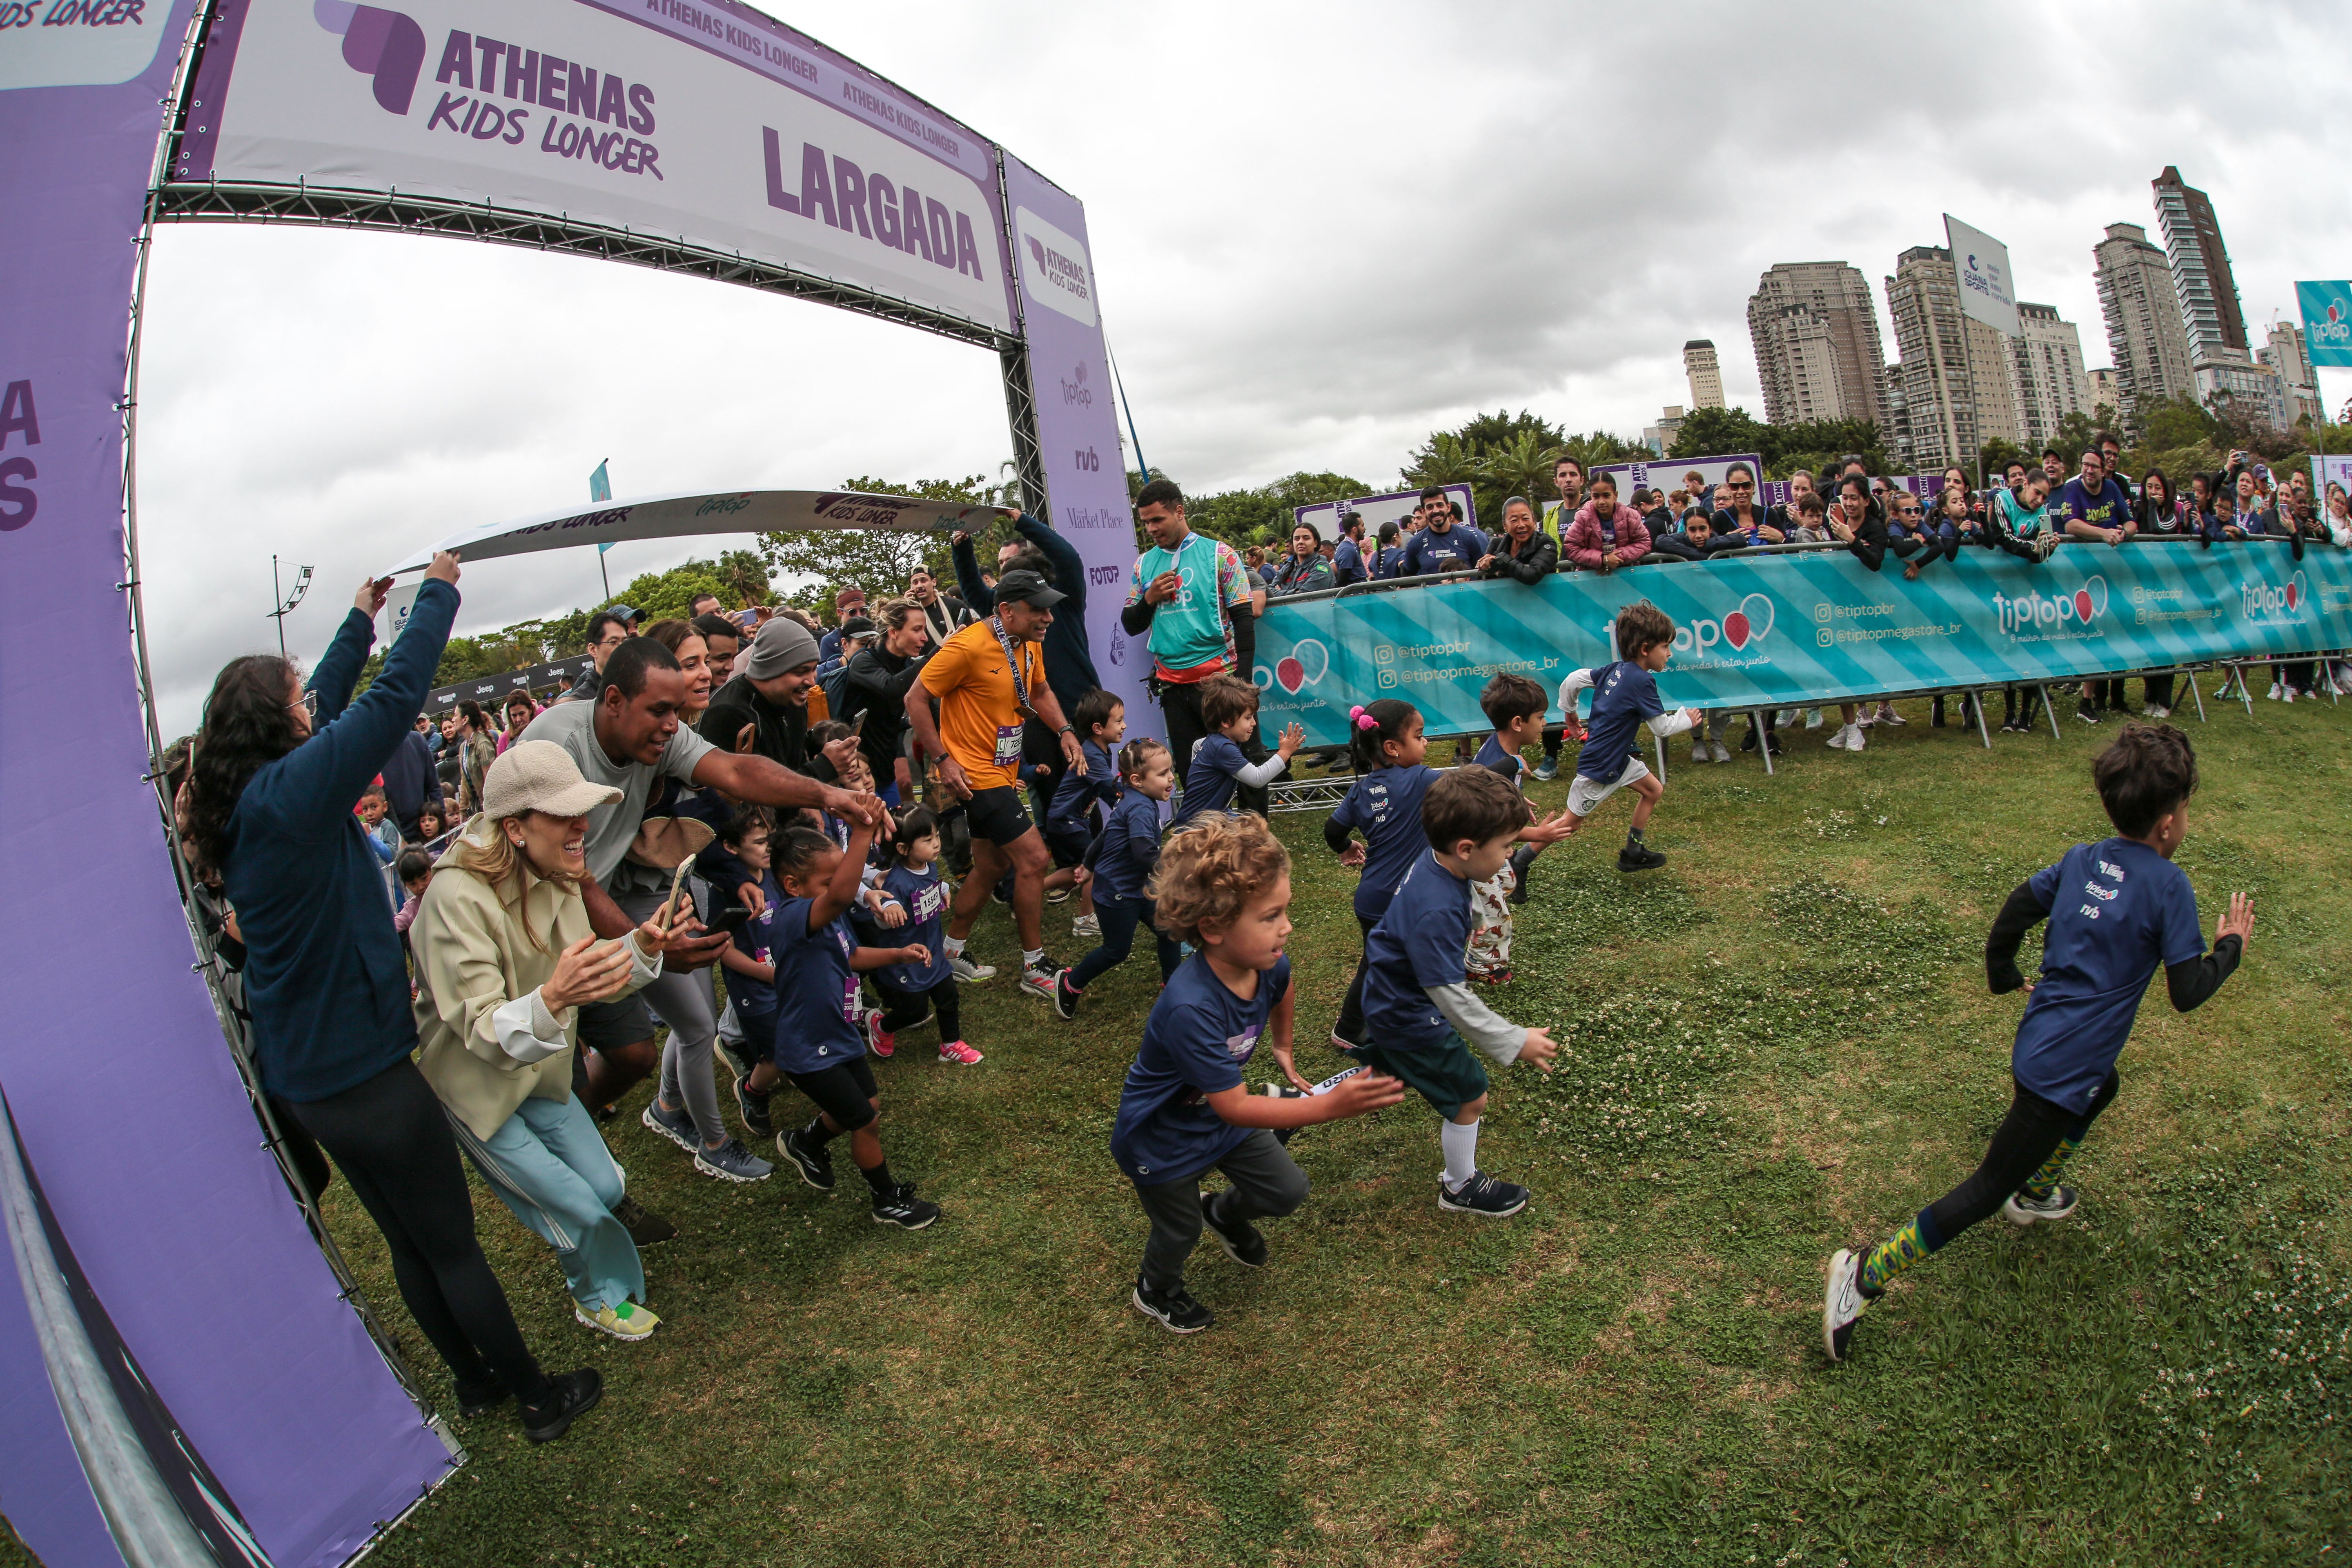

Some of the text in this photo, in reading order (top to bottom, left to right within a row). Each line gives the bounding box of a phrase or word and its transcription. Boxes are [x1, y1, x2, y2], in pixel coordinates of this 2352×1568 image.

[0, 0, 145, 31] IDS LONGER
[646, 0, 818, 84] ATHENAS KIDS LONGER
[435, 29, 655, 136] ATHENAS
[843, 81, 960, 159] ATHENAS KIDS LONGER
[427, 91, 664, 181] KIDS LONGER
[762, 125, 984, 282] LARGADA
[1046, 247, 1085, 285] ATHENAS
[1049, 270, 1089, 301] KIDS LONGER
[1963, 269, 1988, 287] IGUANA
[1964, 278, 1989, 296] SPORTS
[2310, 320, 2350, 342] tiptop
[1060, 377, 1091, 410] tiptop
[1631, 464, 1641, 481] ATH
[1774, 482, 1784, 504] LONG
[1920, 476, 1928, 497] LONG
[695, 497, 751, 517] tiptop
[824, 506, 898, 525] KIDS LONGER
[931, 514, 966, 530] tiptop
[1066, 508, 1123, 529] Market Place
[1089, 565, 1119, 587] FOTOP
[1834, 602, 1895, 619] @tiptopbr
[2241, 581, 2285, 619] tiptop
[394, 617, 410, 626] IGUA
[1992, 589, 2074, 635] tiptop
[1603, 619, 1720, 662] top
[1836, 622, 1962, 644] @tiptopmegastore_br
[1398, 640, 1470, 659] @tiptopbr
[548, 668, 565, 677] Jeep
[1401, 656, 1559, 684] @tiptopmegastore_br
[1676, 661, 1689, 671] da
[1690, 658, 1713, 670] vida
[1721, 657, 1745, 667] estar
[1744, 654, 1771, 669] junto
[476, 684, 494, 694] Jeep
[1277, 701, 1300, 710] estar
[1300, 698, 1327, 712] junto
[923, 891, 938, 908] 15549
